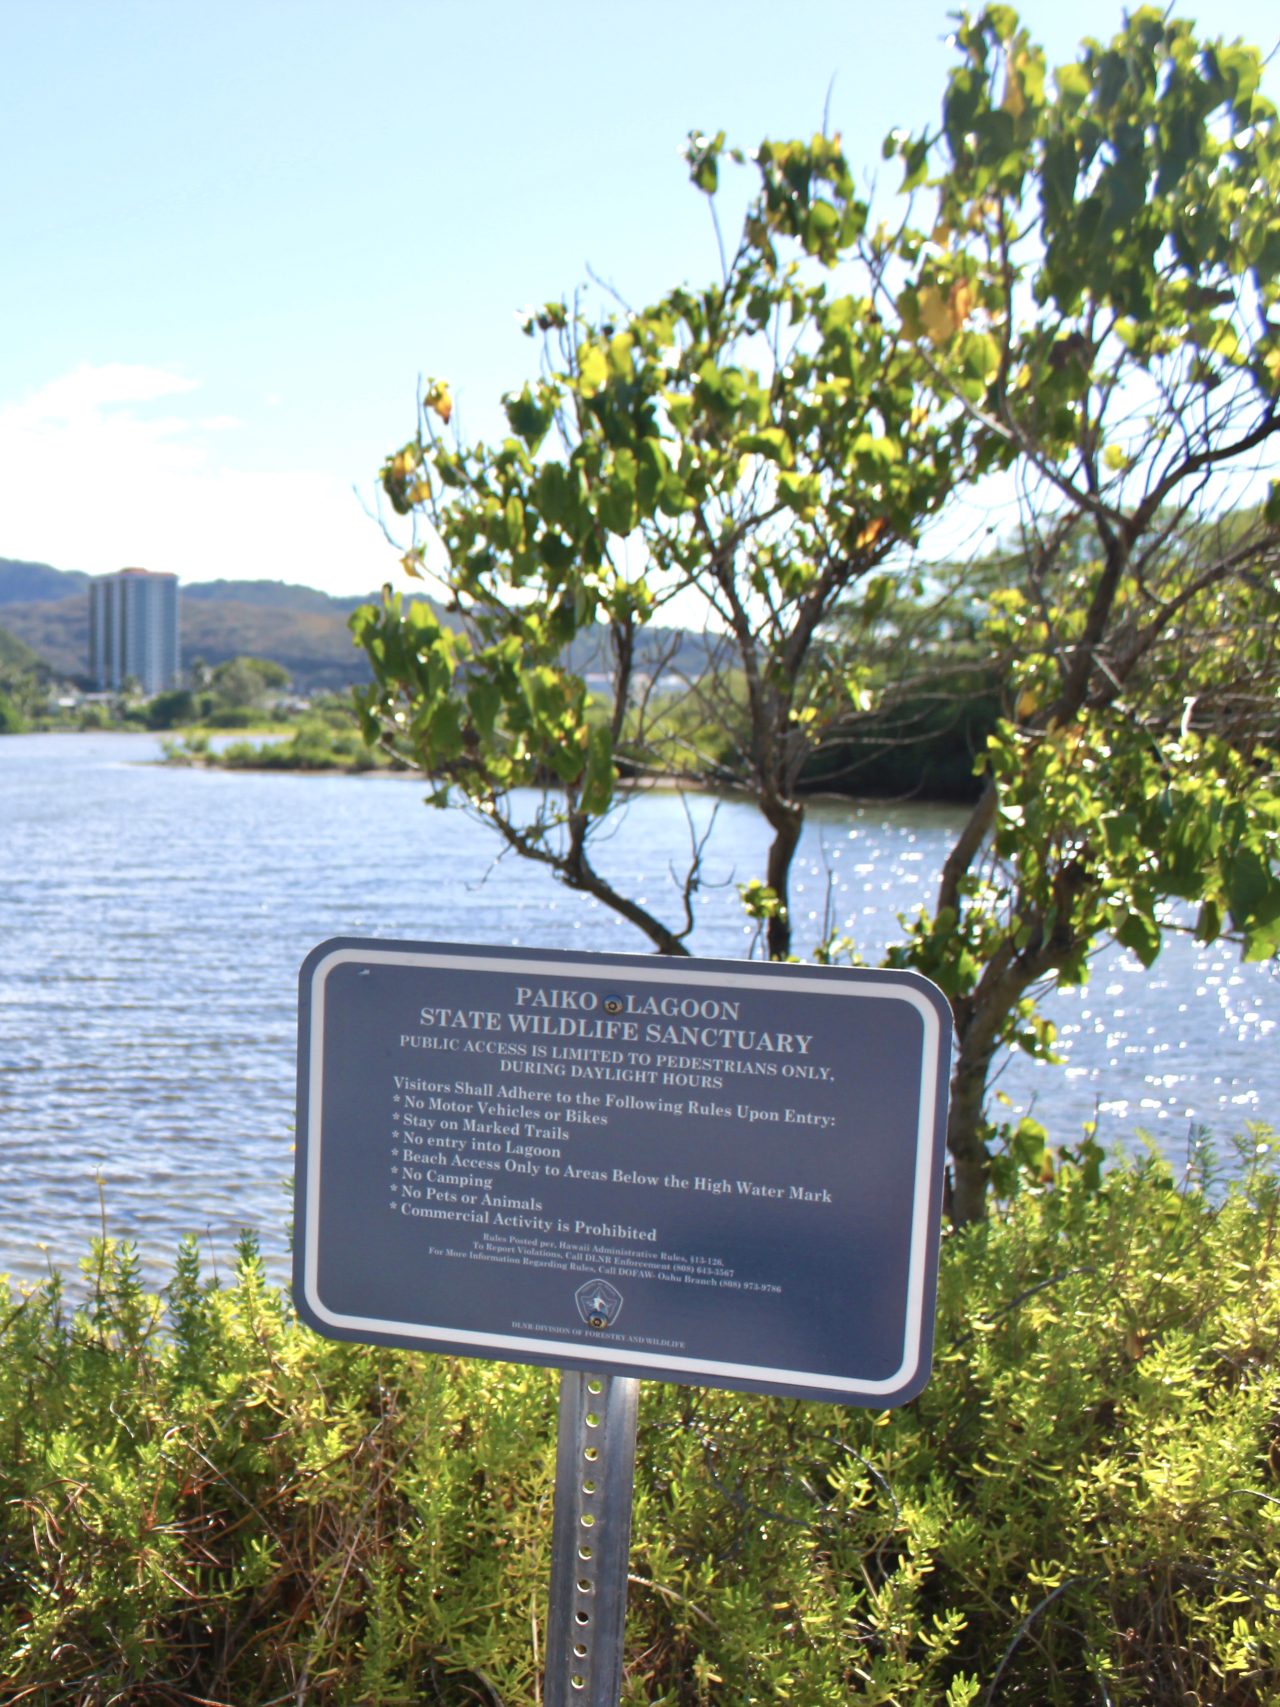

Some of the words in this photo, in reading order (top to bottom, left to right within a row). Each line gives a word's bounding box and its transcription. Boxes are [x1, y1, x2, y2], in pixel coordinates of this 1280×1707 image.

[515, 986, 598, 1010] PAIKO
[625, 994, 740, 1020] LAGOON
[419, 1007, 501, 1030] STATE
[507, 1013, 638, 1041] WILDLIFE
[645, 1023, 813, 1054] SANCTUARY
[399, 1034, 459, 1050] PUBLIC
[463, 1039, 527, 1055] ACCESS
[531, 1044, 547, 1057] IS
[552, 1046, 623, 1063] LIMITED
[627, 1051, 651, 1065] TO
[656, 1054, 777, 1075] PEDESTRIANS
[500, 1059, 566, 1076] DURING
[570, 1064, 658, 1083] DAYLIGHT
[662, 1072, 722, 1088] HOURS
[393, 1075, 451, 1092] Visitors
[454, 1081, 493, 1096] Shall
[496, 1084, 552, 1101] Adhere
[556, 1091, 571, 1103] to
[575, 1091, 600, 1105] the
[605, 1093, 683, 1115] Following
[687, 1100, 732, 1116] Rules
[736, 1104, 779, 1122] Upon
[783, 1108, 835, 1128] Entry:
[404, 1094, 424, 1108] No
[428, 1096, 473, 1113] Motor
[477, 1100, 540, 1118] Vehicles
[543, 1110, 561, 1121] or
[565, 1108, 608, 1125] Bikes
[402, 1113, 435, 1130] Stay
[439, 1119, 458, 1130] on
[462, 1117, 519, 1136] Marked
[523, 1123, 569, 1140] Trails
[402, 1130, 423, 1144] No
[426, 1136, 466, 1151] entry
[471, 1137, 501, 1152] into
[505, 1139, 560, 1158] Lagoon
[401, 1166, 422, 1180] No
[426, 1169, 493, 1190] Camping
[402, 1148, 447, 1165] Beach
[450, 1153, 500, 1170] Access
[504, 1158, 540, 1176] Only
[544, 1164, 560, 1176] to
[563, 1164, 607, 1180] Areas
[612, 1168, 659, 1185] Below
[663, 1174, 689, 1189] the
[693, 1176, 731, 1194] High
[735, 1180, 784, 1198] Water
[788, 1185, 832, 1203] Mark
[401, 1184, 421, 1198] No
[425, 1186, 457, 1201] Pets
[460, 1194, 477, 1204] or
[480, 1192, 542, 1210] Animals
[400, 1202, 489, 1223] Commercial
[492, 1212, 552, 1232] Activity
[557, 1218, 569, 1231] is
[574, 1219, 656, 1241] Prohibited
[472, 1240, 484, 1250] To
[485, 1242, 515, 1253] Report
[564, 1251, 583, 1261] Call
[584, 1253, 611, 1264] DLNR
[613, 1256, 670, 1270] Enforcement
[672, 1262, 695, 1273] (808)
[482, 1232, 507, 1242] Rules
[508, 1235, 538, 1246] Posted
[558, 1240, 590, 1251] Hawaii
[593, 1244, 658, 1258] Administrative
[428, 1246, 443, 1255] For
[445, 1247, 467, 1258] More
[468, 1250, 520, 1264] Information
[522, 1256, 567, 1270] Regarding
[598, 1265, 616, 1275] Call
[657, 1272, 682, 1282] Oahu
[684, 1274, 717, 1286] Branch
[718, 1278, 742, 1289] (808)
